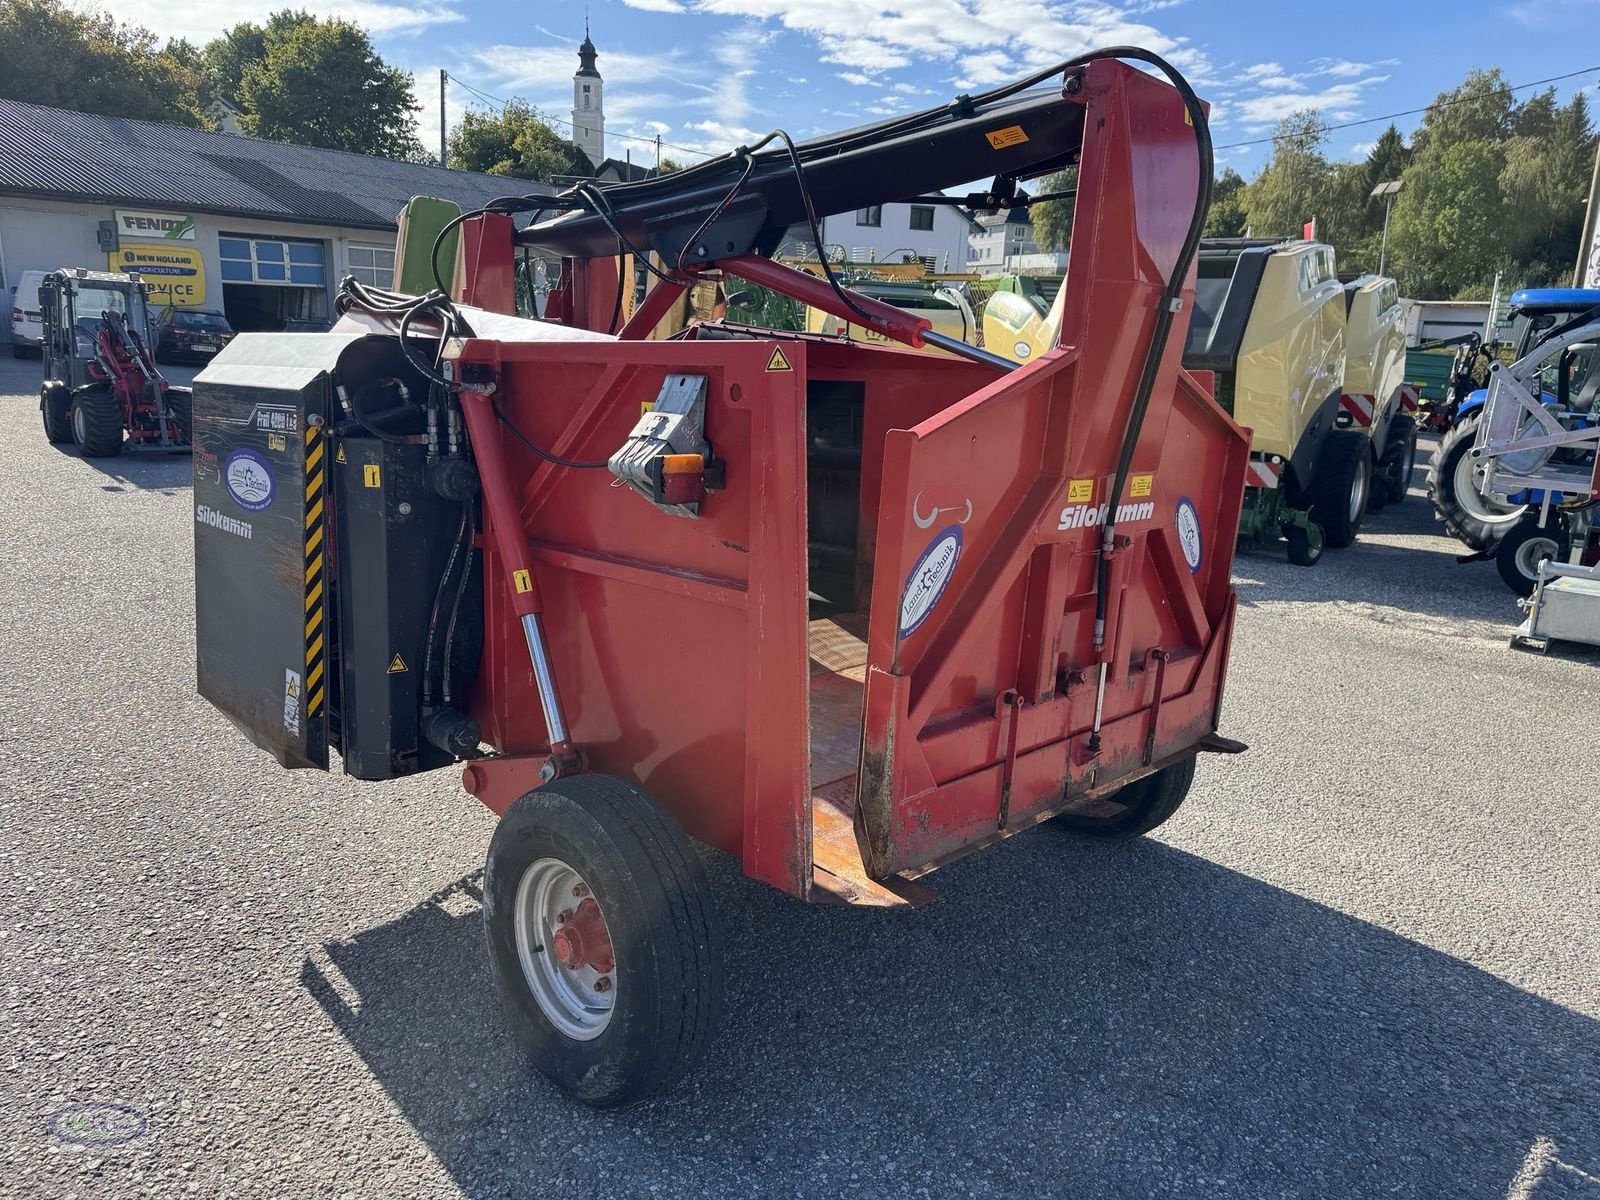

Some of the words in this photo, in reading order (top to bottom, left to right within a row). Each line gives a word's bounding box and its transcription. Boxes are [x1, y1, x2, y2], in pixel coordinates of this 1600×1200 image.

[122, 215, 184, 232] FENDT
[136, 254, 155, 263] NEW
[156, 255, 192, 265] HOLLAND
[138, 266, 181, 275] AGRICULTURE
[232, 463, 246, 480] Land
[196, 504, 253, 540] Silokamm
[1057, 501, 1155, 531] Silokmm
[903, 584, 925, 616] Land
[926, 543, 955, 586] Technik
